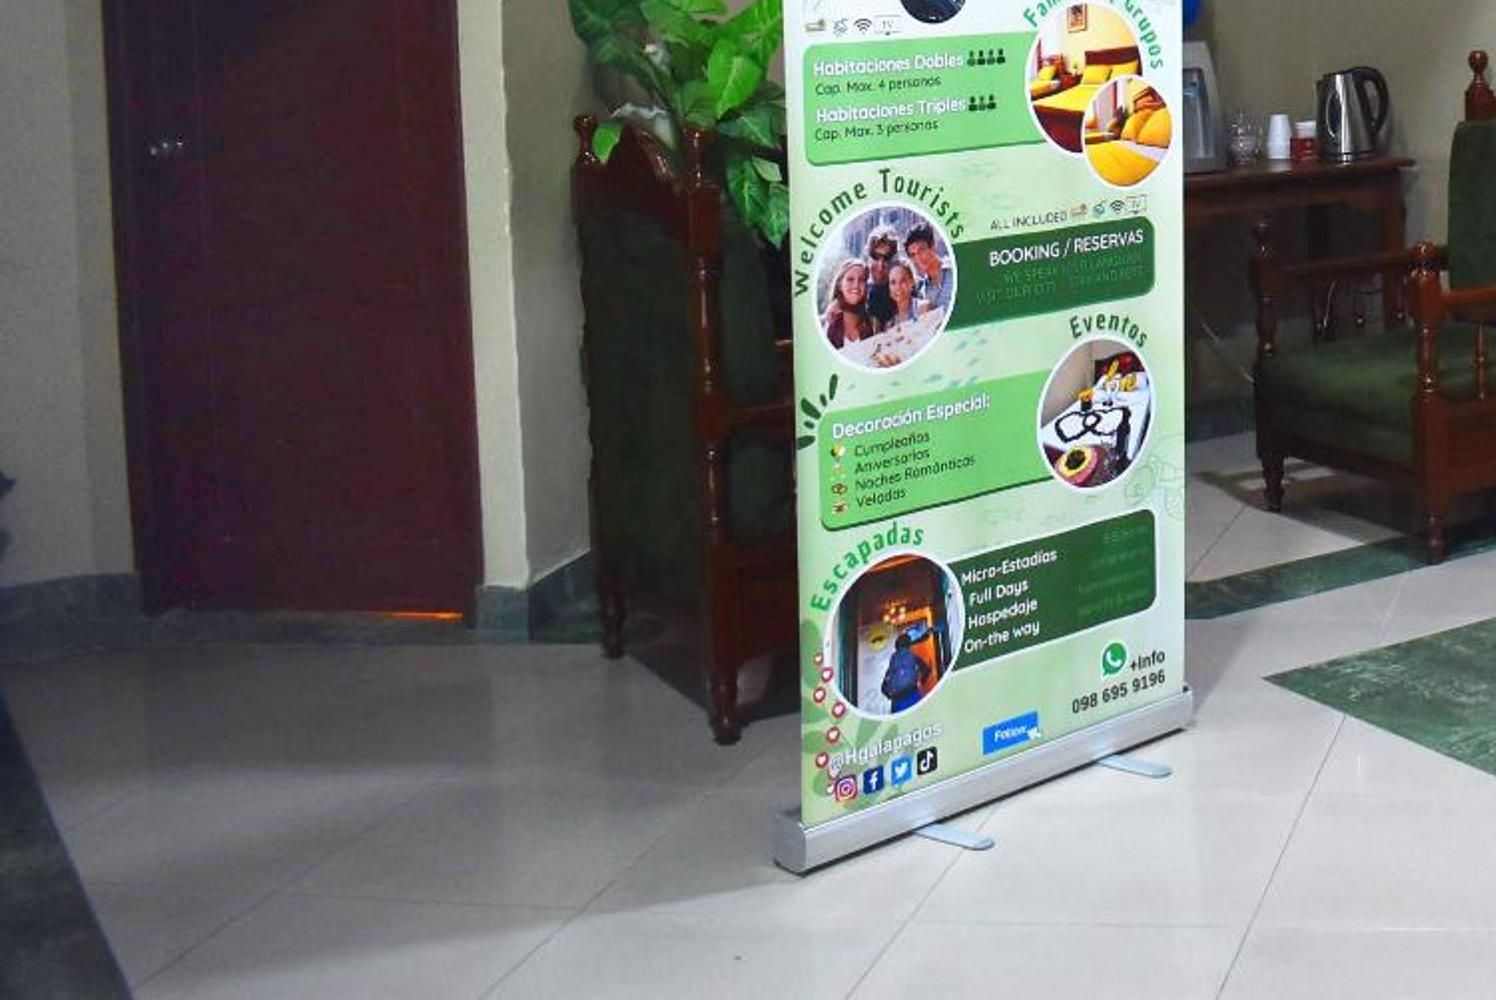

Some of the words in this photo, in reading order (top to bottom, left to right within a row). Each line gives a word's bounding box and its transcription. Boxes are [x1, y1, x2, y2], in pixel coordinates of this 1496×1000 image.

[813, 55, 911, 77] Habitaciones
[914, 51, 965, 70] Dobles
[888, 74, 943, 92] personas
[816, 101, 915, 124] Habitaciones
[876, 124, 885, 136] 3
[886, 119, 940, 137] personas
[878, 166, 965, 240] Tourists
[1012, 212, 1068, 230] INCLUDED
[988, 243, 1061, 268] BOOKING
[1073, 228, 1145, 254] RESERVAS
[1070, 313, 1148, 348] Eventos
[832, 408, 923, 439] Decoración
[926, 392, 991, 423] Especial:
[854, 430, 931, 458] Cumpleaños
[854, 448, 931, 474] Aniversarios
[855, 472, 902, 492] Noches
[904, 455, 977, 481] Románticas
[856, 487, 907, 508] Veladas
[810, 520, 924, 611] Escapadas
[969, 587, 992, 606] Full
[996, 578, 1029, 600] Days
[968, 599, 1038, 630] Hospedaje
[1013, 620, 1040, 638] way
[1072, 692, 1098, 714] 098
[1102, 682, 1128, 703] 695
[1132, 668, 1166, 693] 9196
